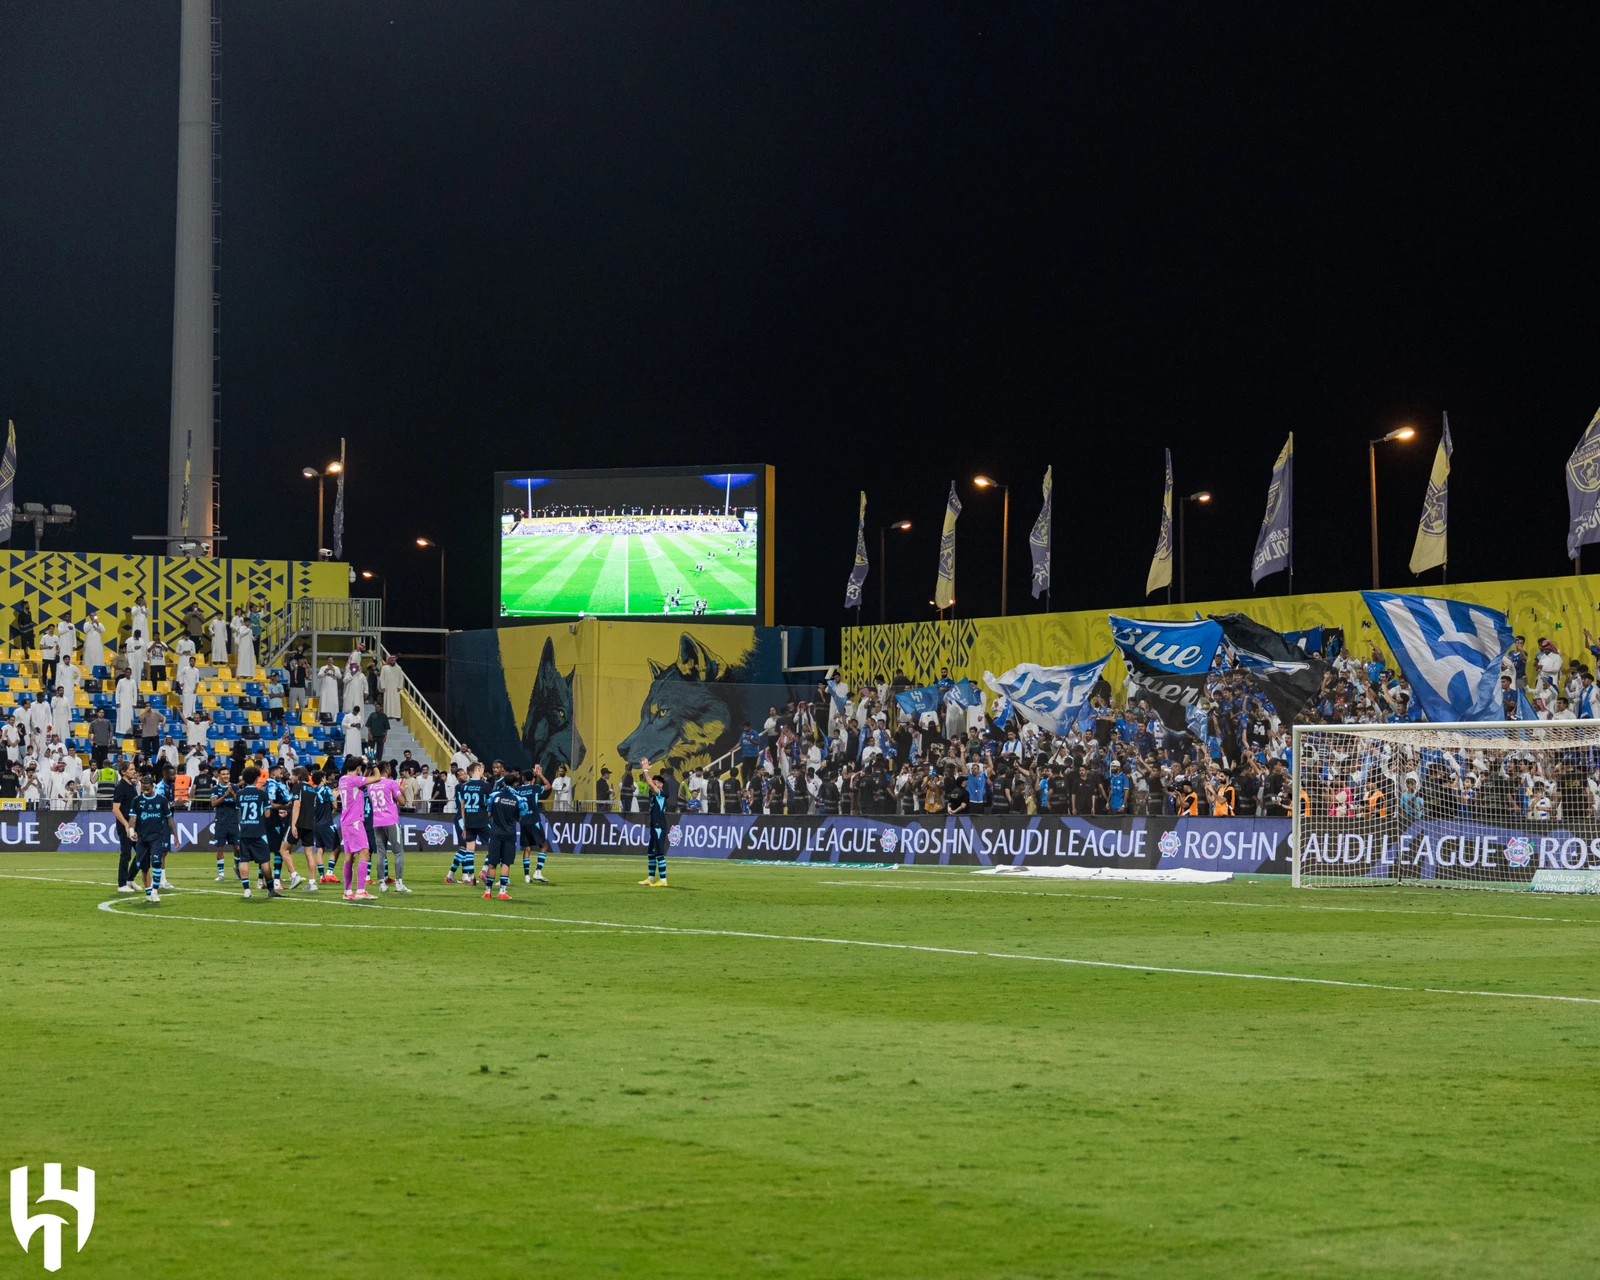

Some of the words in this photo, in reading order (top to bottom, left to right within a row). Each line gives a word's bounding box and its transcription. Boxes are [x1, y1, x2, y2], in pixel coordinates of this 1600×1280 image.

[1112, 626, 1203, 669] Blue
[240, 801, 258, 821] 73
[370, 789, 386, 807] 33
[464, 792, 480, 809] 22
[552, 822, 598, 845] SAUDI
[601, 823, 651, 847] LEAGU
[684, 824, 744, 850] ROSHN
[747, 826, 802, 851] SAUDI
[805, 827, 878, 853] LEAGUE
[900, 828, 974, 854] ROSHN
[979, 828, 1050, 856] SAUDI
[1054, 829, 1148, 858] LEAGUE
[1183, 830, 1278, 861] ROSHN
[1381, 834, 1499, 867] LEAGUE
